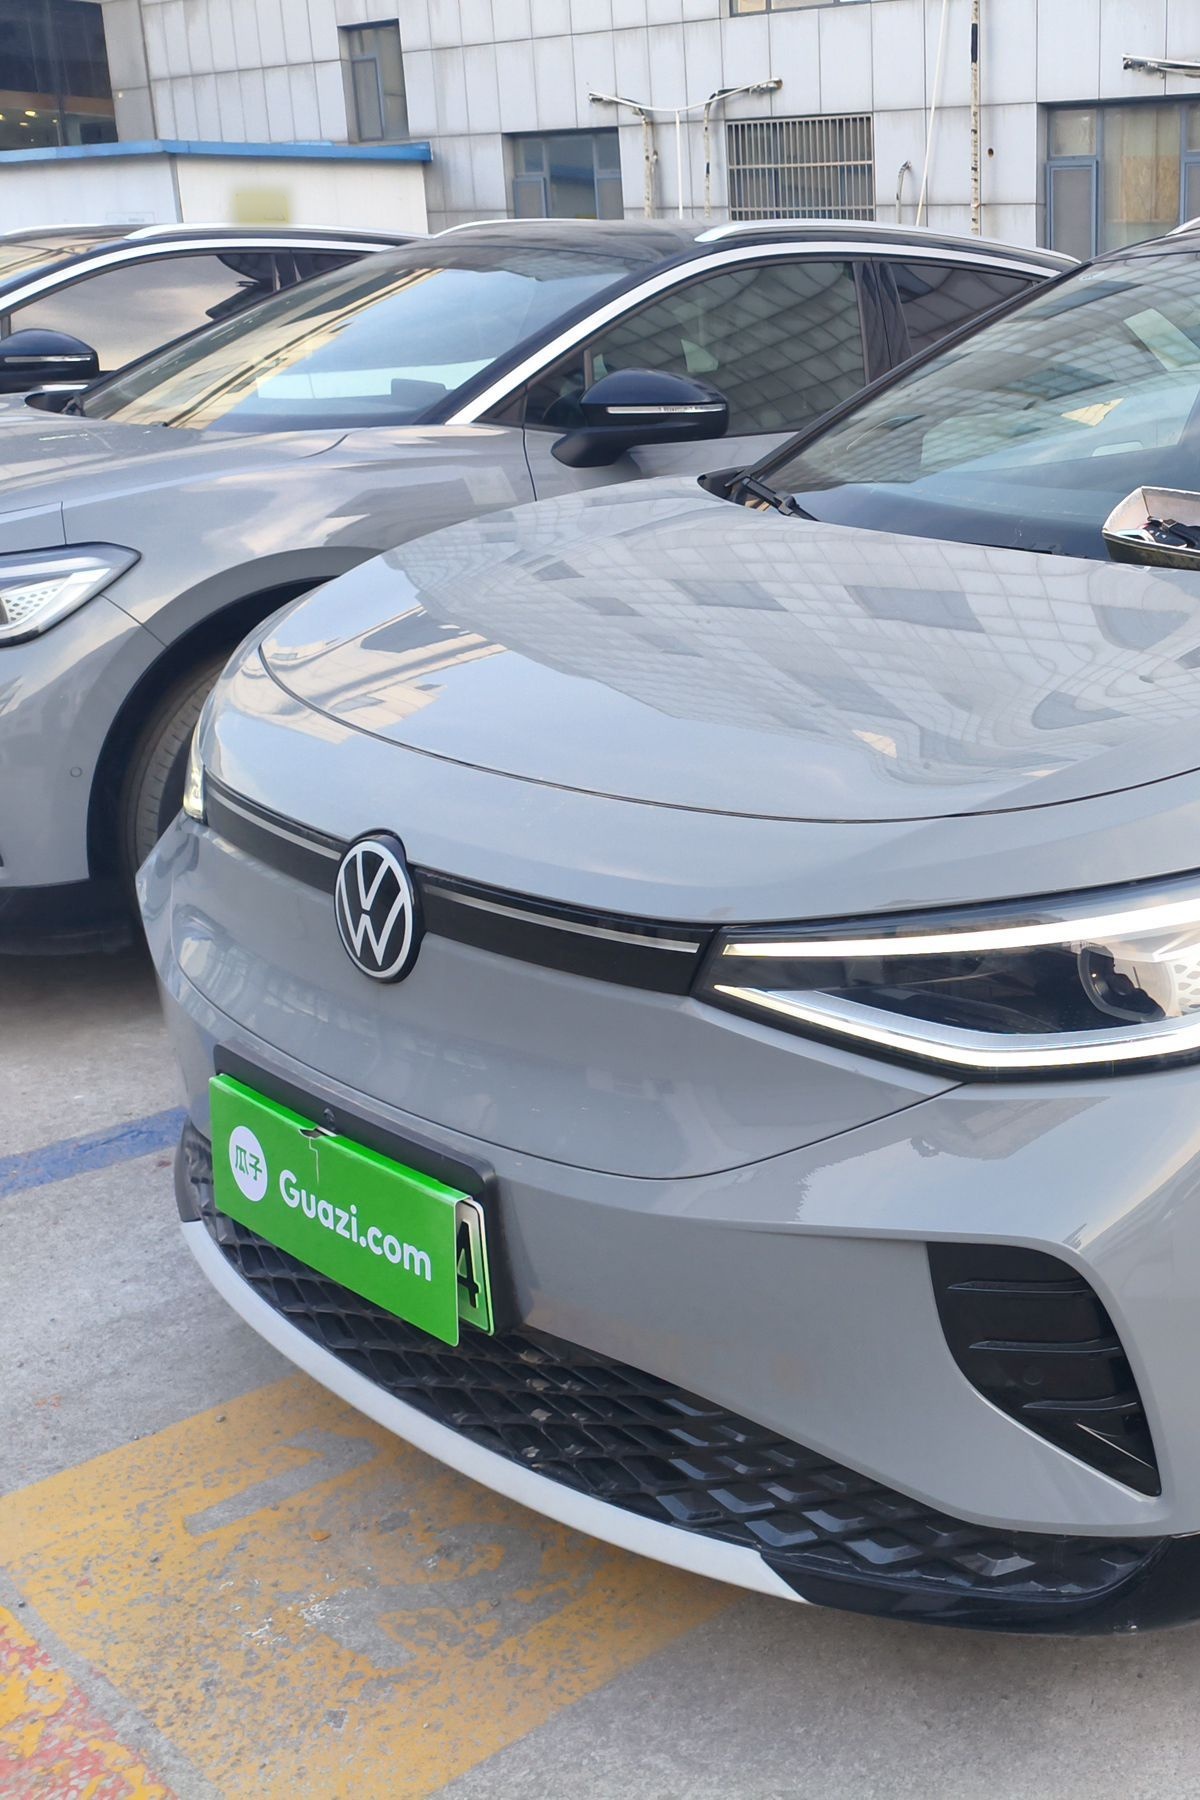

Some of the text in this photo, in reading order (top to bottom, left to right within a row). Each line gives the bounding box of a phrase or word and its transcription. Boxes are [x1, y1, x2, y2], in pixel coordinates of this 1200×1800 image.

[335, 845, 410, 970] VW
[235, 1144, 263, 1181] 瓜子
[279, 1169, 432, 1282] Guazi.com
